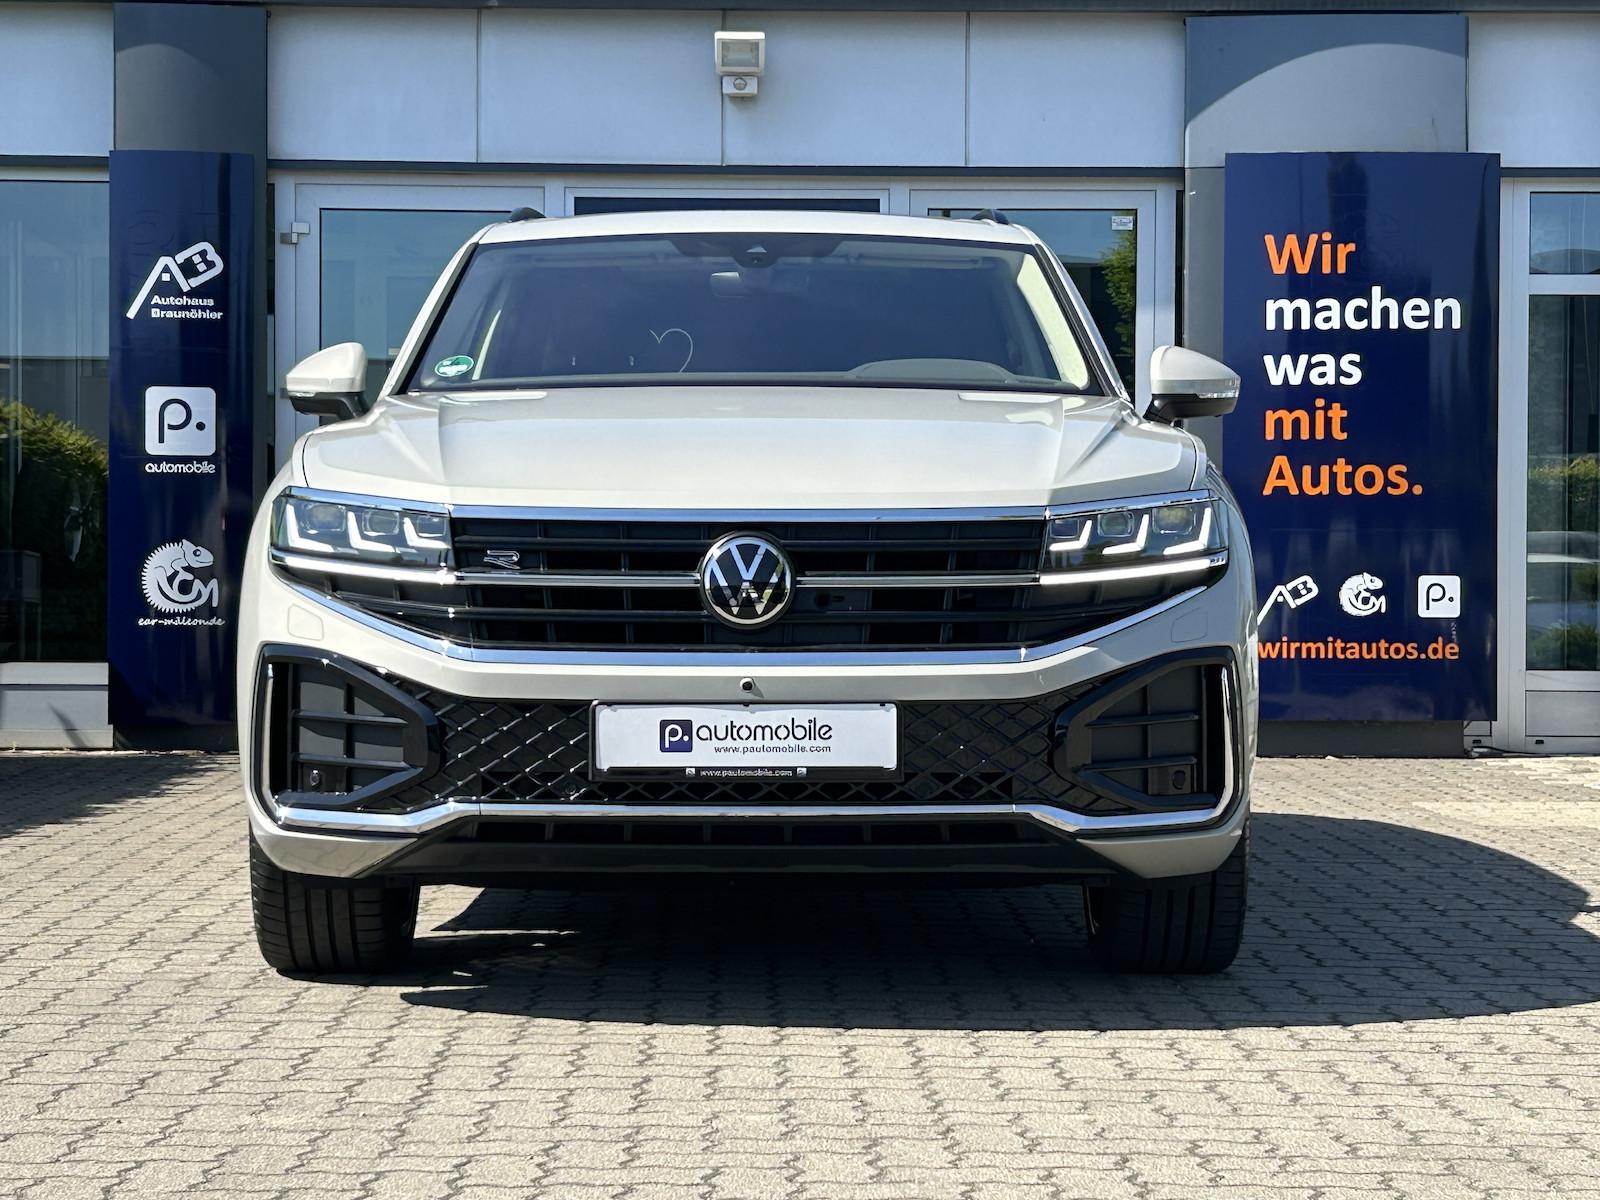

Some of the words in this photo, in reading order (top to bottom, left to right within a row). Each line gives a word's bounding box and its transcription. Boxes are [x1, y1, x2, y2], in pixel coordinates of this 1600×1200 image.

[1264, 232, 1356, 275] Wir
[151, 295, 214, 306] Autohaus
[1265, 285, 1462, 331] machen
[151, 308, 224, 320] Braunöhler
[1263, 353, 1363, 386] was
[1264, 398, 1349, 441] mit
[145, 461, 216, 474] automobile
[1262, 455, 1424, 496] Autos.
[1258, 636, 1461, 660] wirmitautos.de
[696, 717, 833, 741] automobile
[714, 743, 832, 755] www.pautomobile.com
